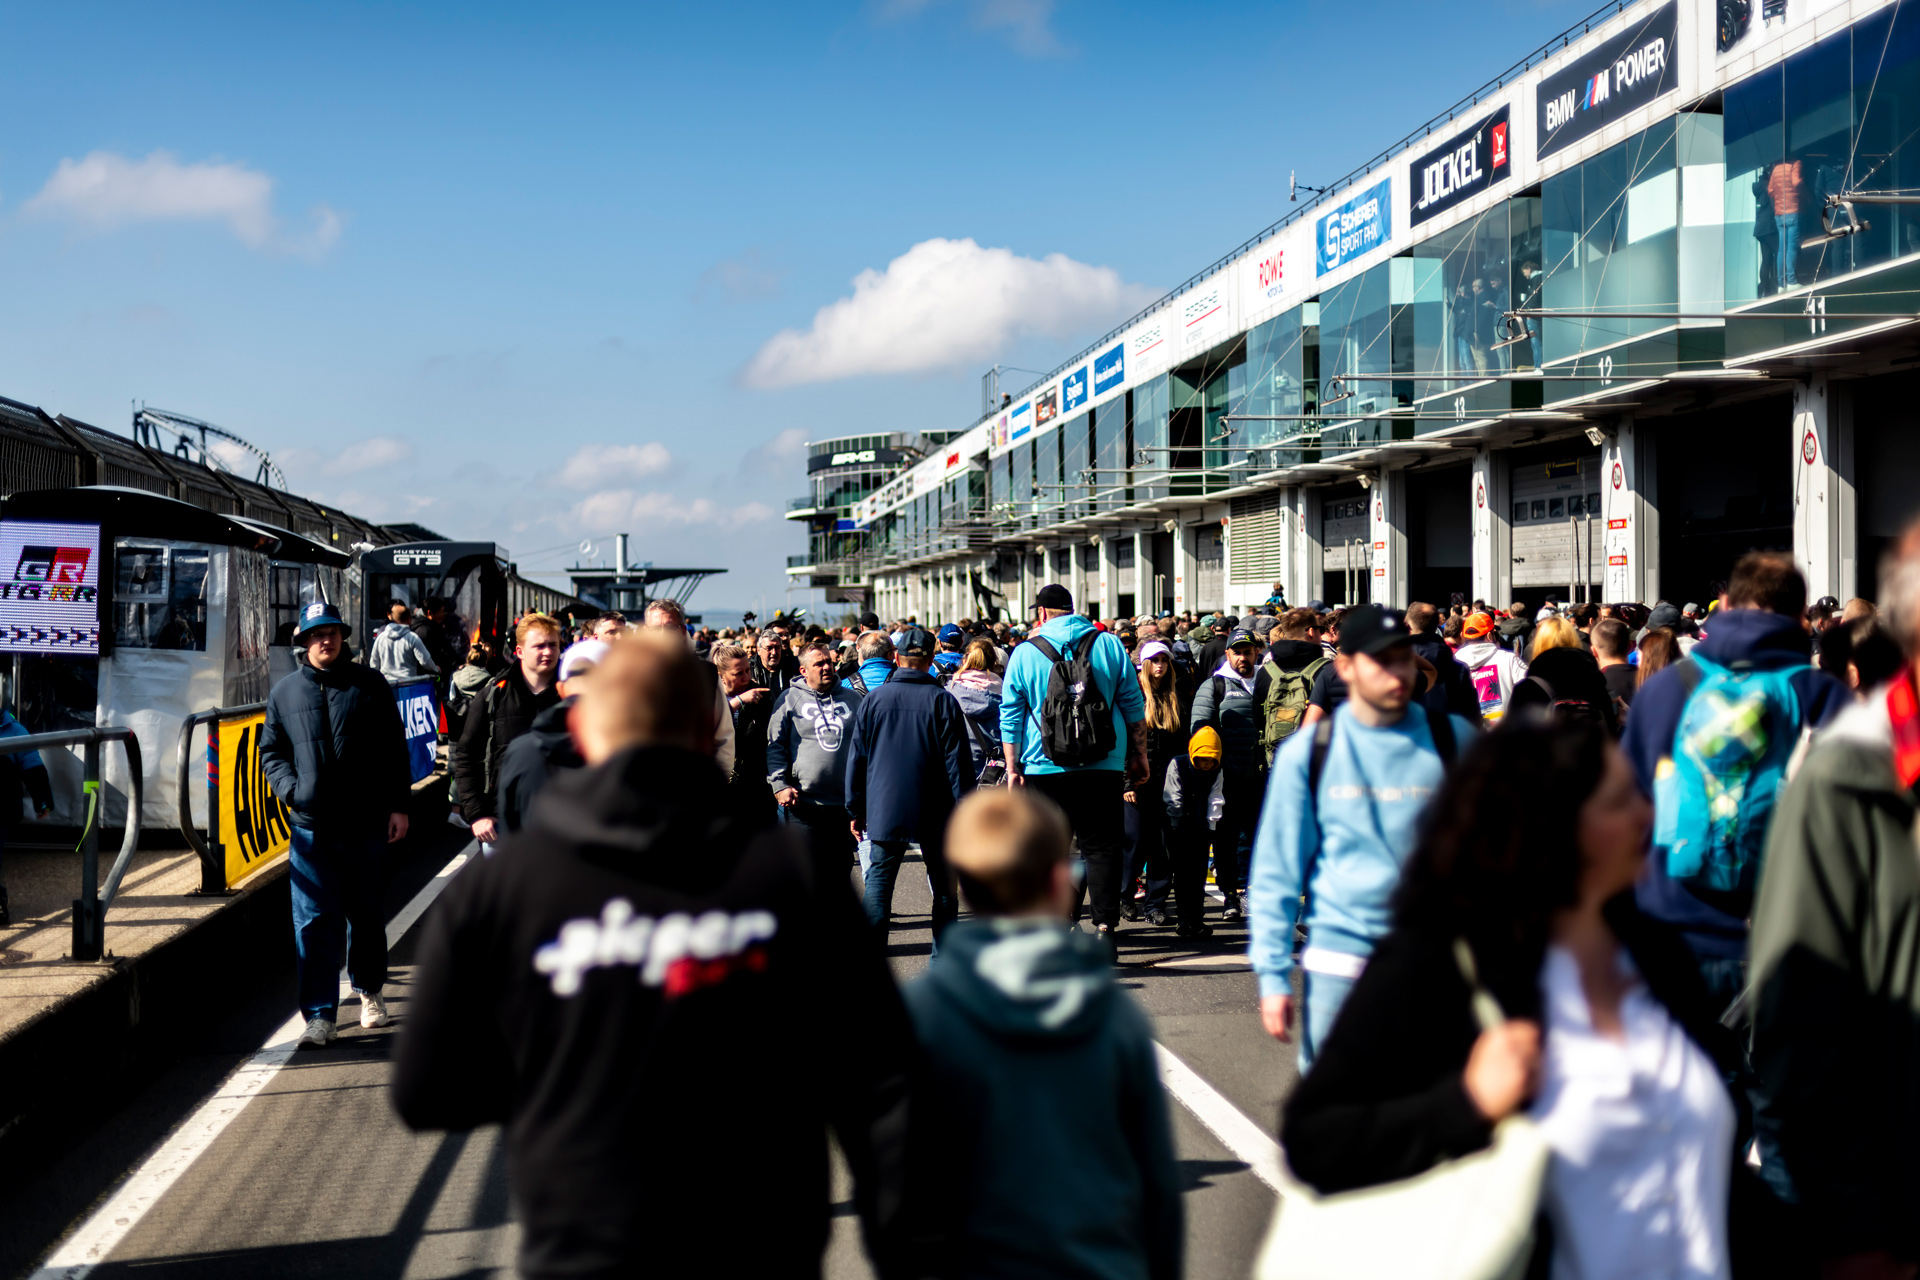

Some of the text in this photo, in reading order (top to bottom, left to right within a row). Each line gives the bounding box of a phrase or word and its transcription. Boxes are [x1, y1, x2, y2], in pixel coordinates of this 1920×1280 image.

[1546, 88, 1576, 132] BMW
[1616, 37, 1665, 92] POWER
[1341, 197, 1378, 234] SCHERER
[1341, 229, 1363, 256] SPORT
[1259, 249, 1284, 290] ROWE
[1809, 296, 1826, 334] 11
[1599, 355, 1613, 386] 12
[1454, 396, 1466, 423] 13
[17, 560, 86, 581] GR
[393, 554, 442, 566] GT3
[397, 695, 437, 740] LKEN
[234, 722, 291, 864] ADA
